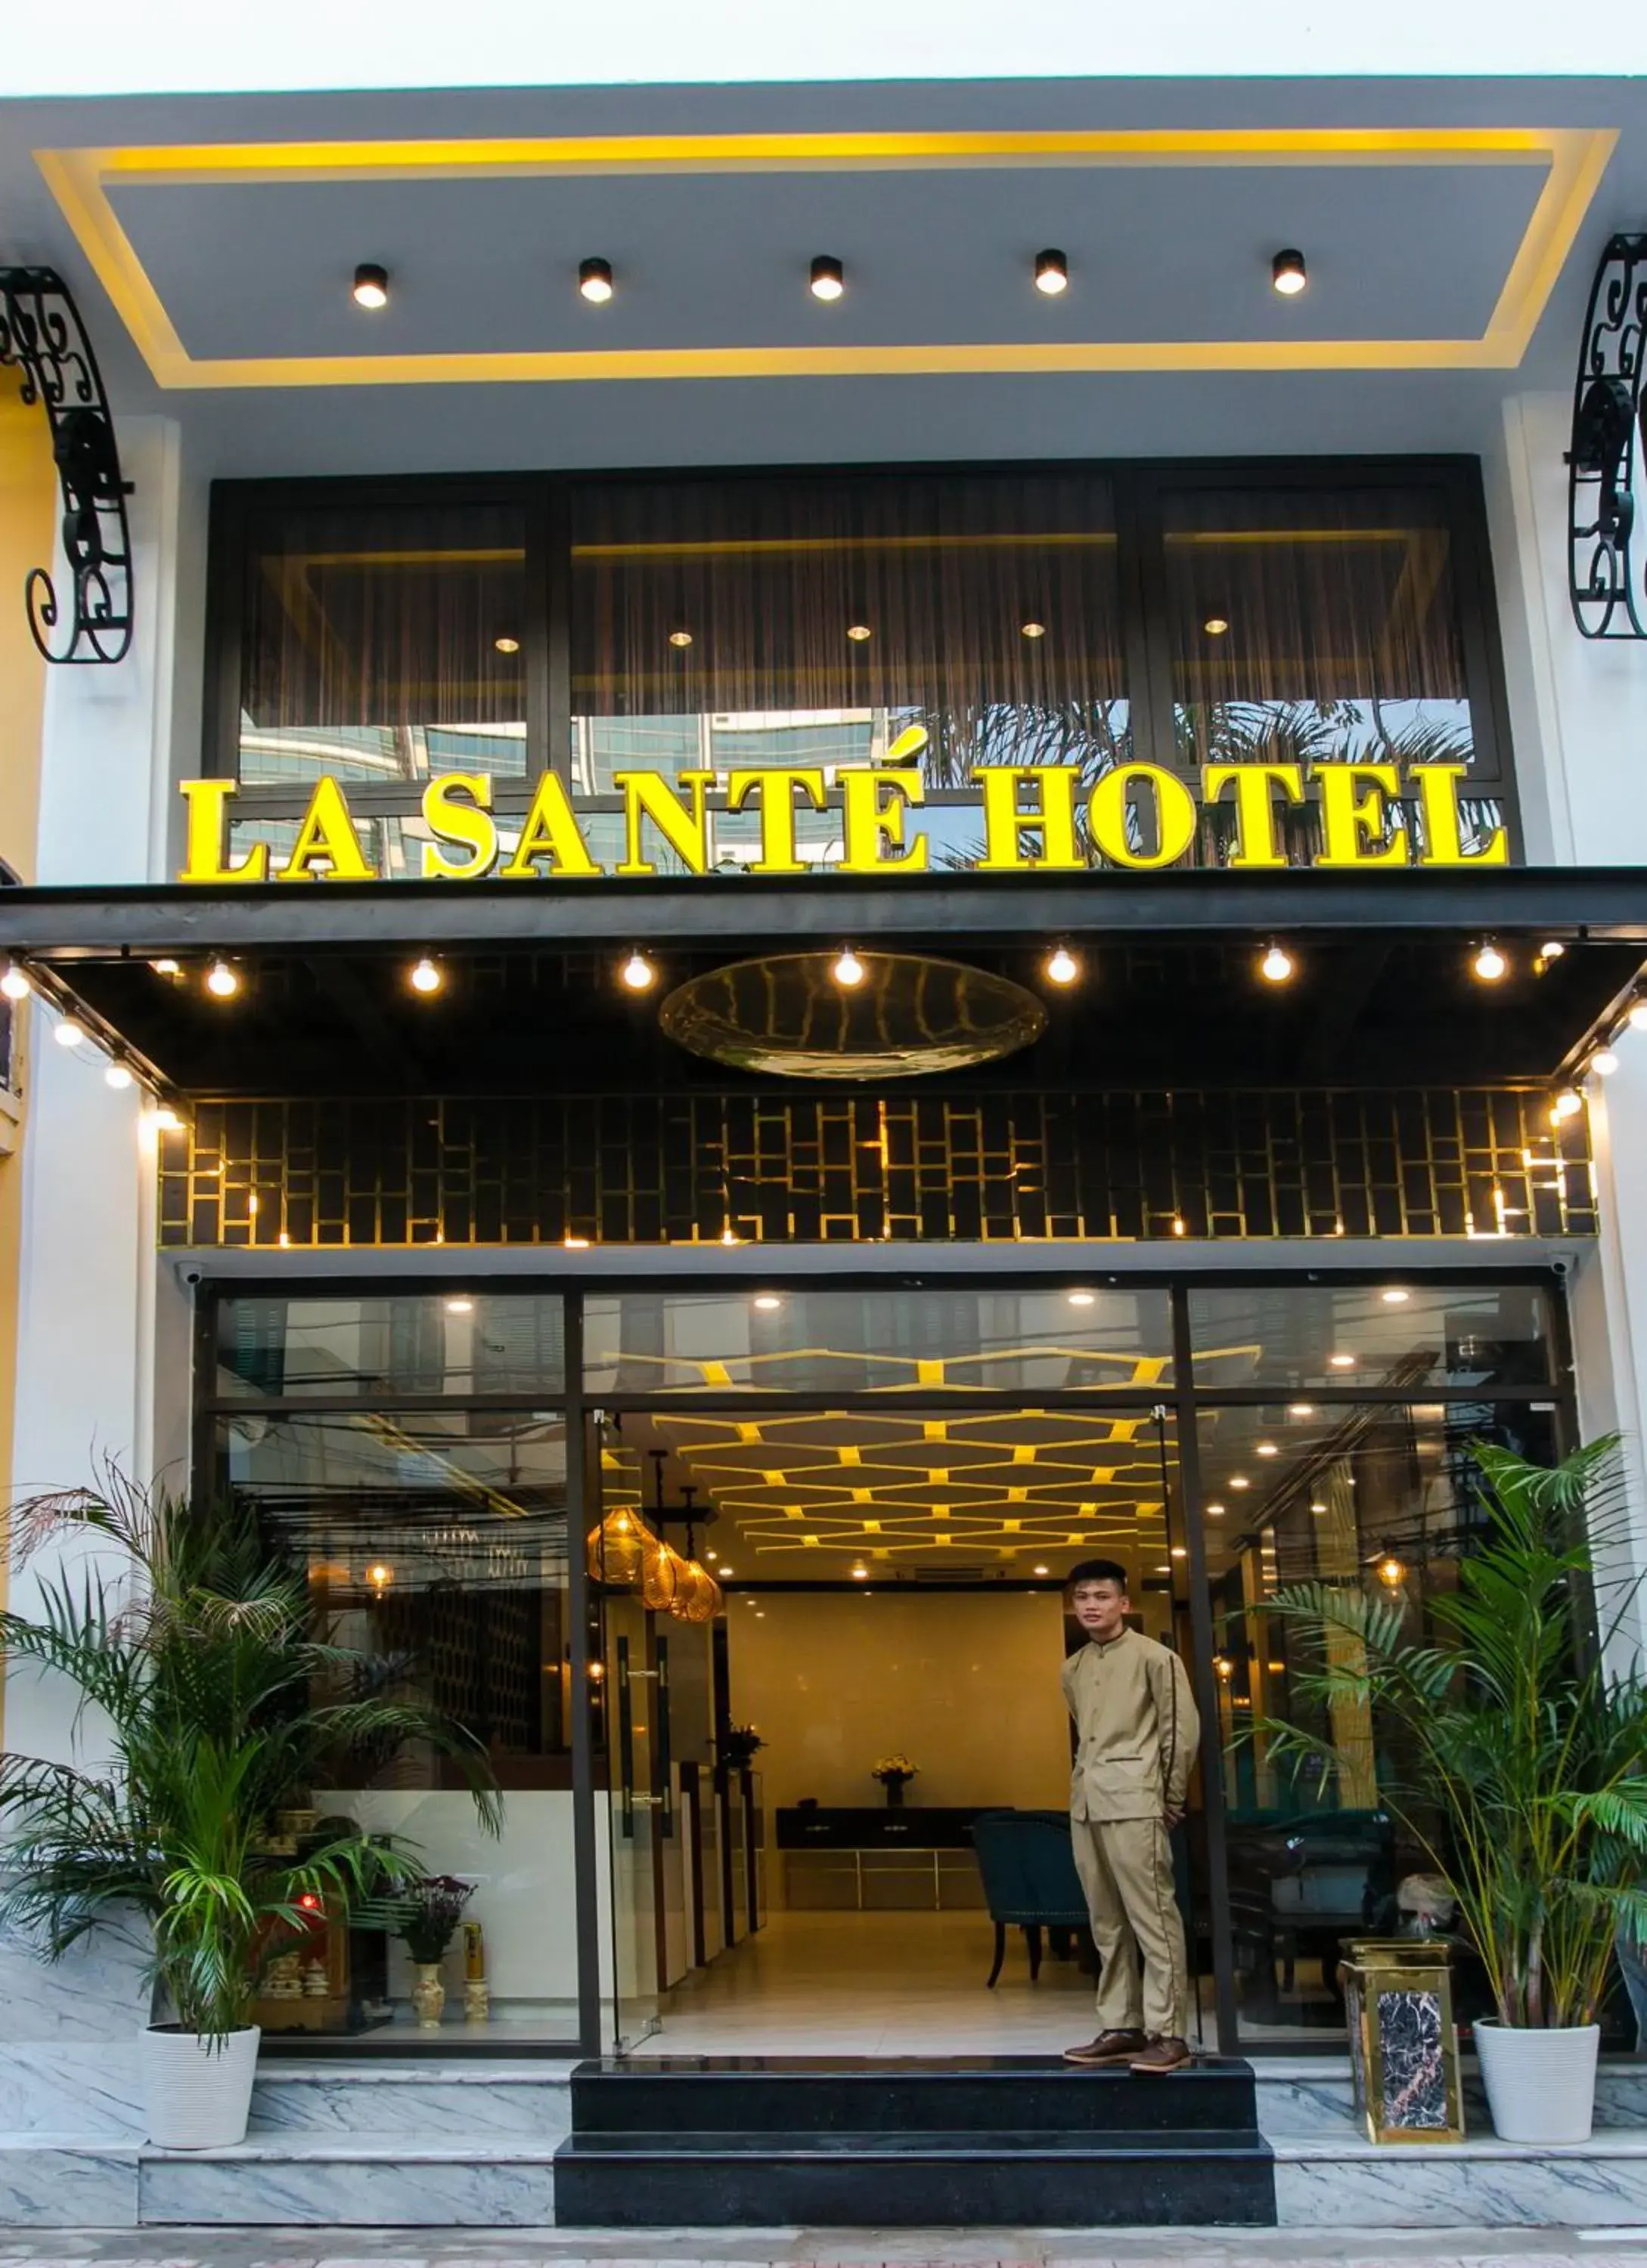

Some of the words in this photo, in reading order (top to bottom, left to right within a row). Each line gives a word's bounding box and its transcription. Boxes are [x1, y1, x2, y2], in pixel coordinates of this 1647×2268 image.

[177, 776, 378, 884] LA
[420, 726, 929, 879] SANTÉ
[971, 761, 1510, 870] HOTEL
